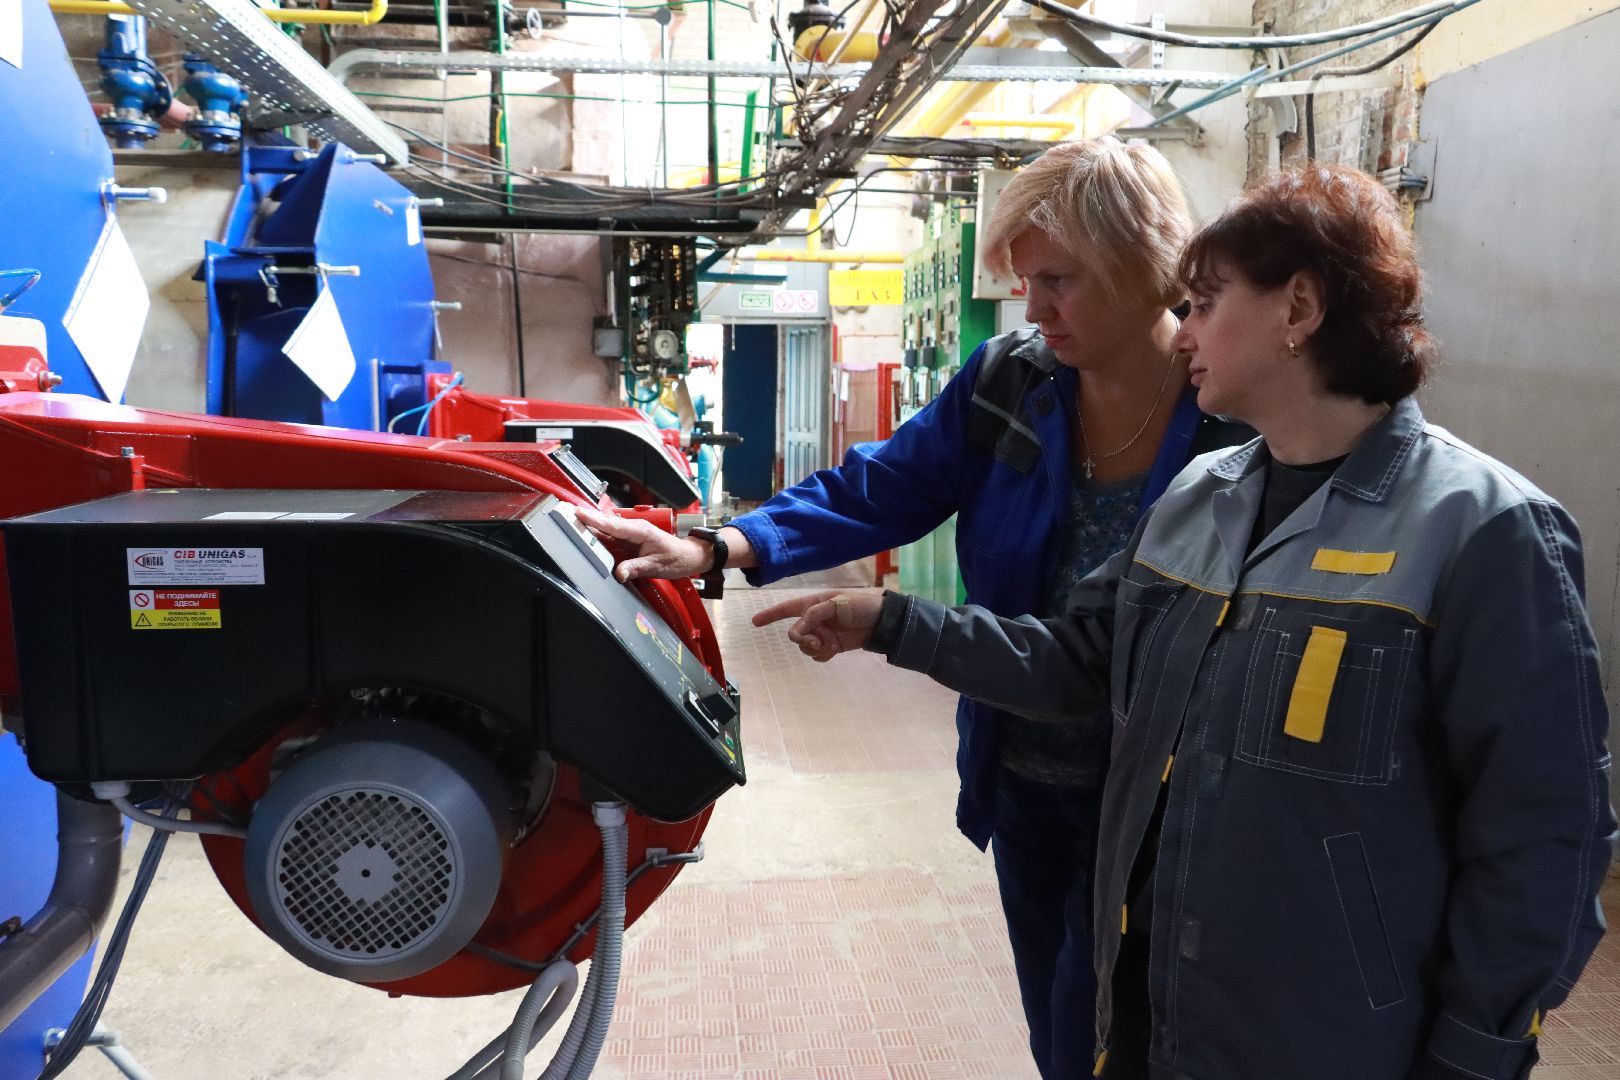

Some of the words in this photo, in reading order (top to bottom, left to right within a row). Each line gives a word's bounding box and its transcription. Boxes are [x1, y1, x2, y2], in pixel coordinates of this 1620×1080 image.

[174, 550, 195, 559] CIB
[198, 549, 245, 559] UNIGAS
[142, 556, 164, 567] UNIGAS
[167, 592, 217, 600] ПОДНИМАЙТЕ
